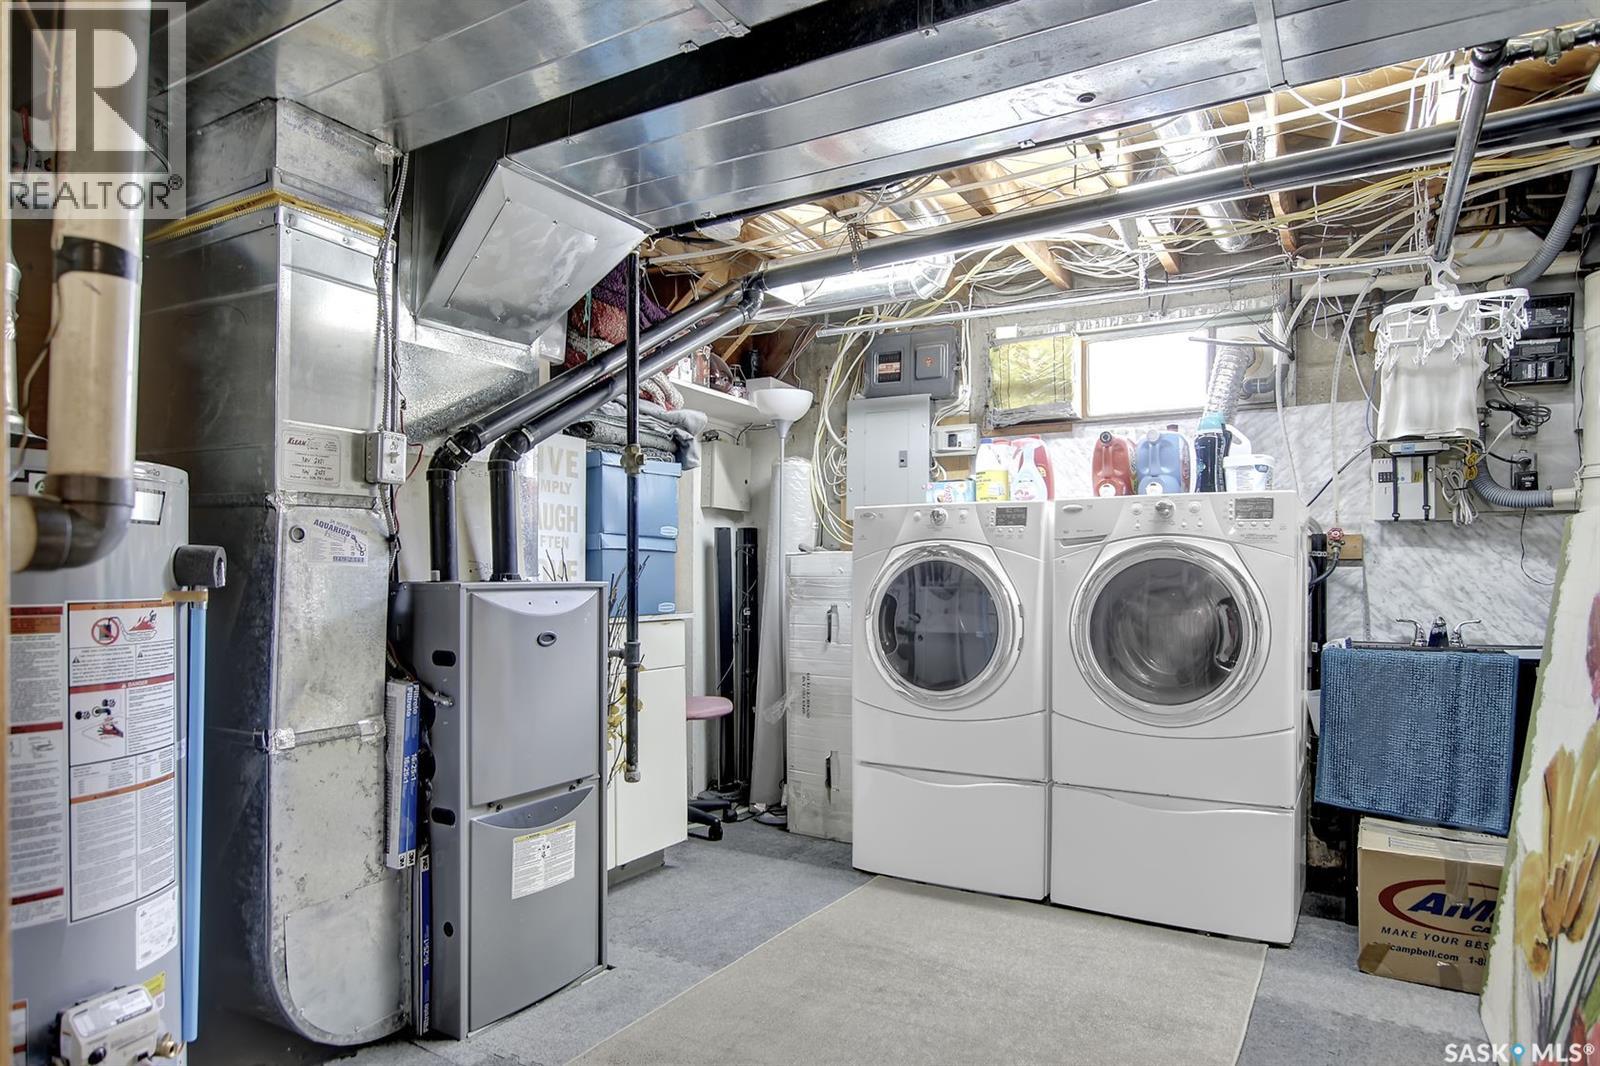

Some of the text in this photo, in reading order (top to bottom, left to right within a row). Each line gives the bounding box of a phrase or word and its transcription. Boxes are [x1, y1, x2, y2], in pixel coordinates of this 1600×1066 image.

[313, 519, 351, 537] AQUARIUS
[1381, 926, 1490, 951] MAKE YOUR BES
[1389, 943, 1459, 962] campbell.com
